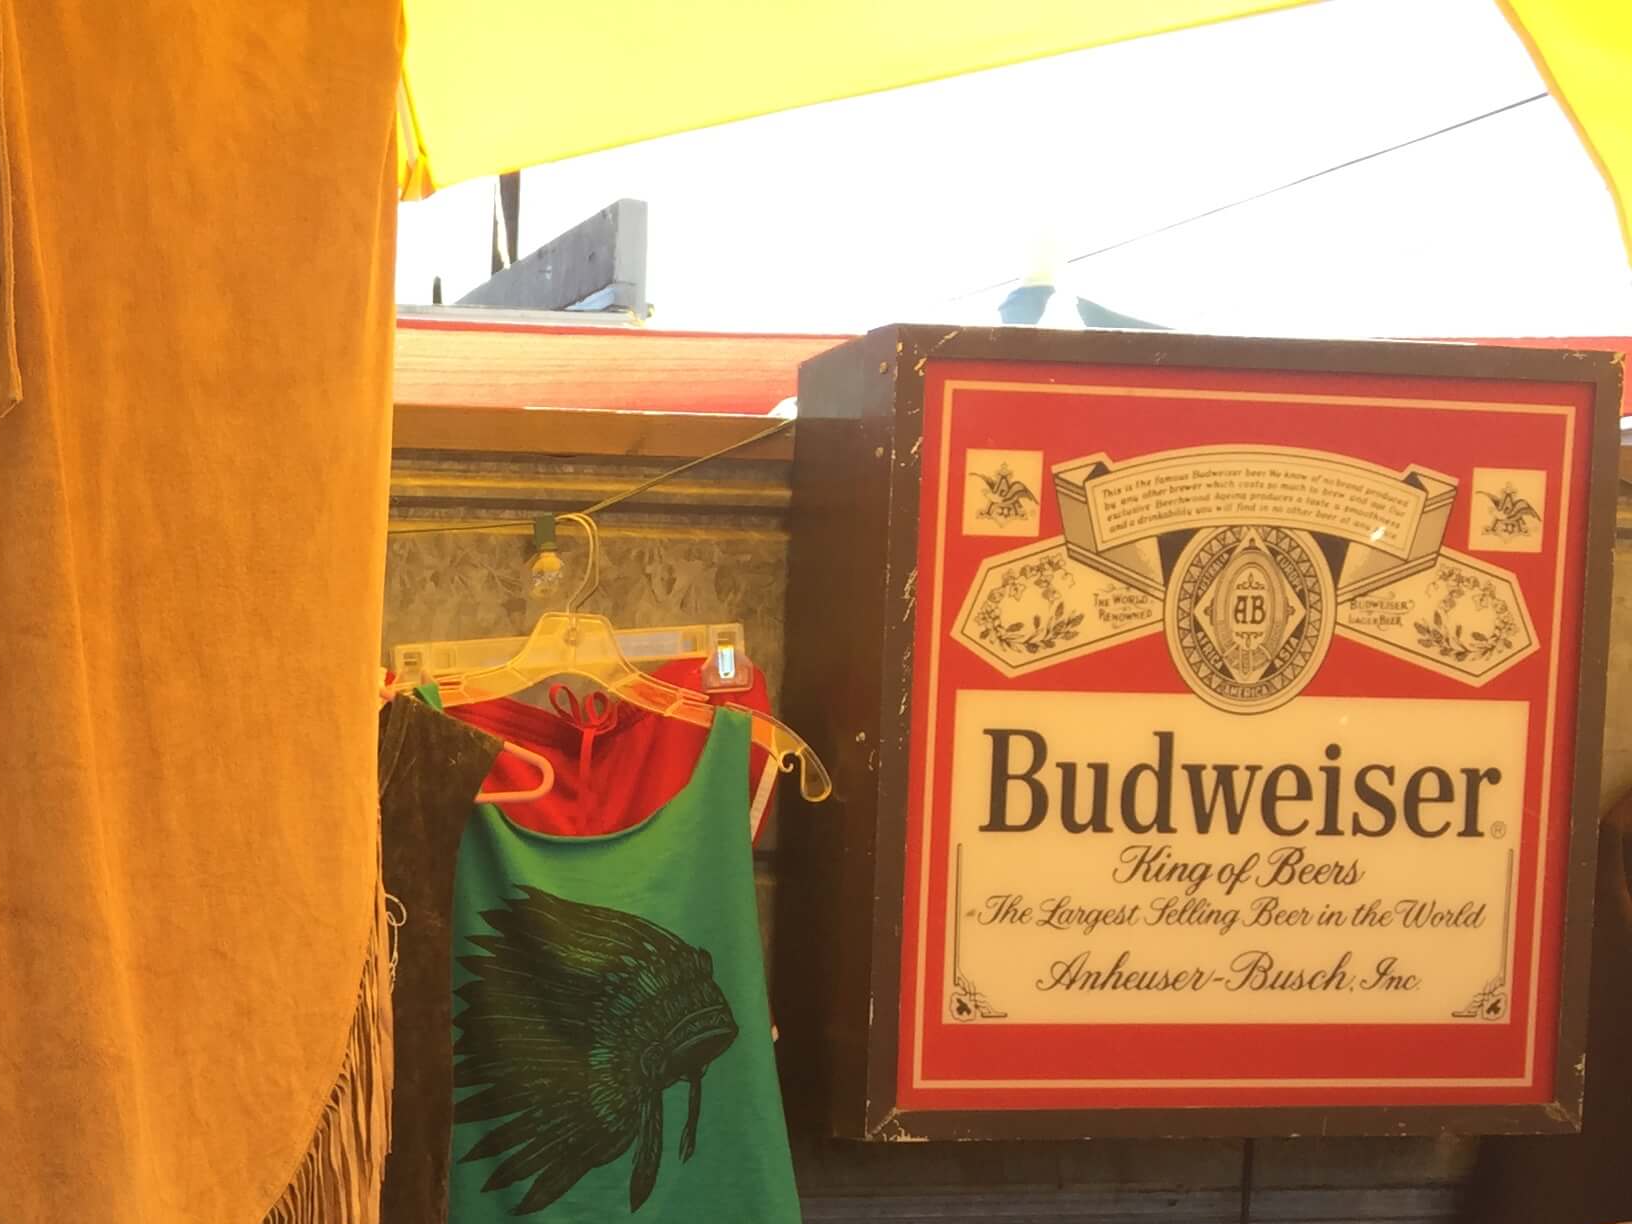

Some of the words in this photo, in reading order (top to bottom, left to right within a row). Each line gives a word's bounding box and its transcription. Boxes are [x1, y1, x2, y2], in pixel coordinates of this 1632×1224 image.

[1102, 488, 1122, 498] This
[1154, 473, 1189, 485] famous
[1192, 469, 1242, 480] Budweiser
[1284, 469, 1308, 480] know
[1335, 478, 1364, 493] brand
[1121, 496, 1138, 506] any
[1142, 488, 1167, 500] other
[1169, 483, 1202, 494] brewer
[1206, 480, 1235, 489] which
[1238, 480, 1265, 489] costs
[1280, 482, 1306, 492] much
[1321, 488, 1345, 499] brew
[1349, 494, 1368, 505] and
[1106, 505, 1150, 522] exclusive
[1154, 493, 1211, 509] Beechwood
[1249, 492, 1294, 502] produces
[1344, 506, 1401, 528] smoothness
[1109, 521, 1127, 534] and
[1137, 508, 1193, 525] drinkability
[1195, 506, 1213, 515] you
[1216, 503, 1233, 512] will
[1236, 503, 1256, 512] find
[1285, 505, 1312, 517] other
[1315, 510, 1337, 521] beer
[1276, 553, 1304, 593] EUROPE
[1113, 594, 1148, 604] WORLD
[1234, 595, 1266, 625] AB
[1196, 631, 1224, 669] AFRICA
[1273, 636, 1300, 669] ASIA
[1222, 683, 1271, 699] AMERICA
[978, 728, 1503, 838] Budweiser
[1111, 844, 1212, 897] King
[1217, 852, 1260, 896] of
[1255, 846, 1366, 888] Beers
[977, 893, 1033, 927] The
[1035, 895, 1140, 936] Largest
[1144, 896, 1241, 936] Selling
[1242, 896, 1312, 929] Beer
[1317, 903, 1347, 928] in
[1351, 898, 1394, 928] the
[1394, 899, 1486, 929] World
